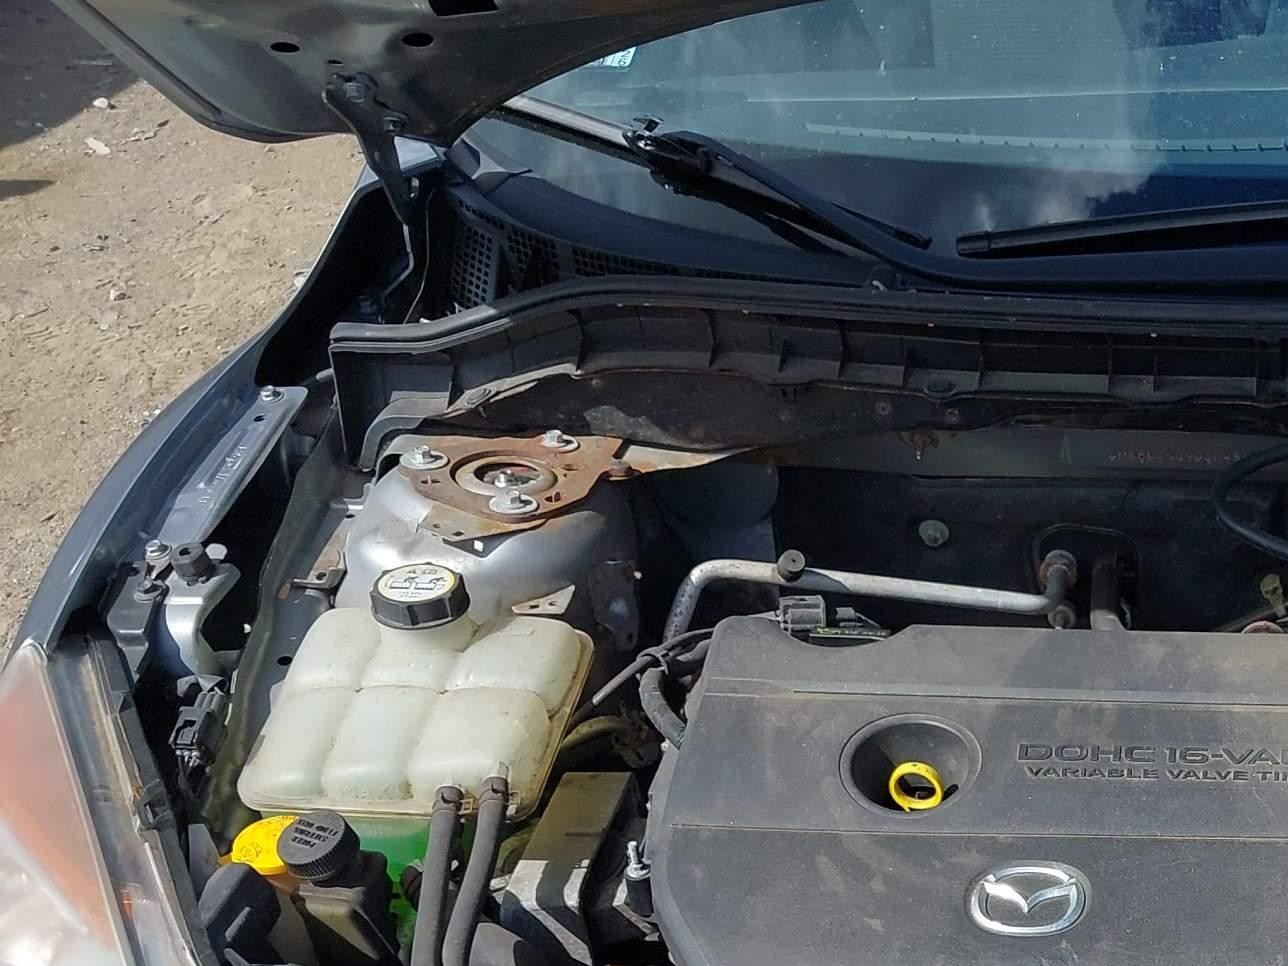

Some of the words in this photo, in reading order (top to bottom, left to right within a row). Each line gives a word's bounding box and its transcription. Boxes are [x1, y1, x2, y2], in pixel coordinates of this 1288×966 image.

[1017, 743, 1156, 763] DOHC
[1025, 765, 1160, 780] VARIABLE
[1167, 768, 1249, 782] VALVE
